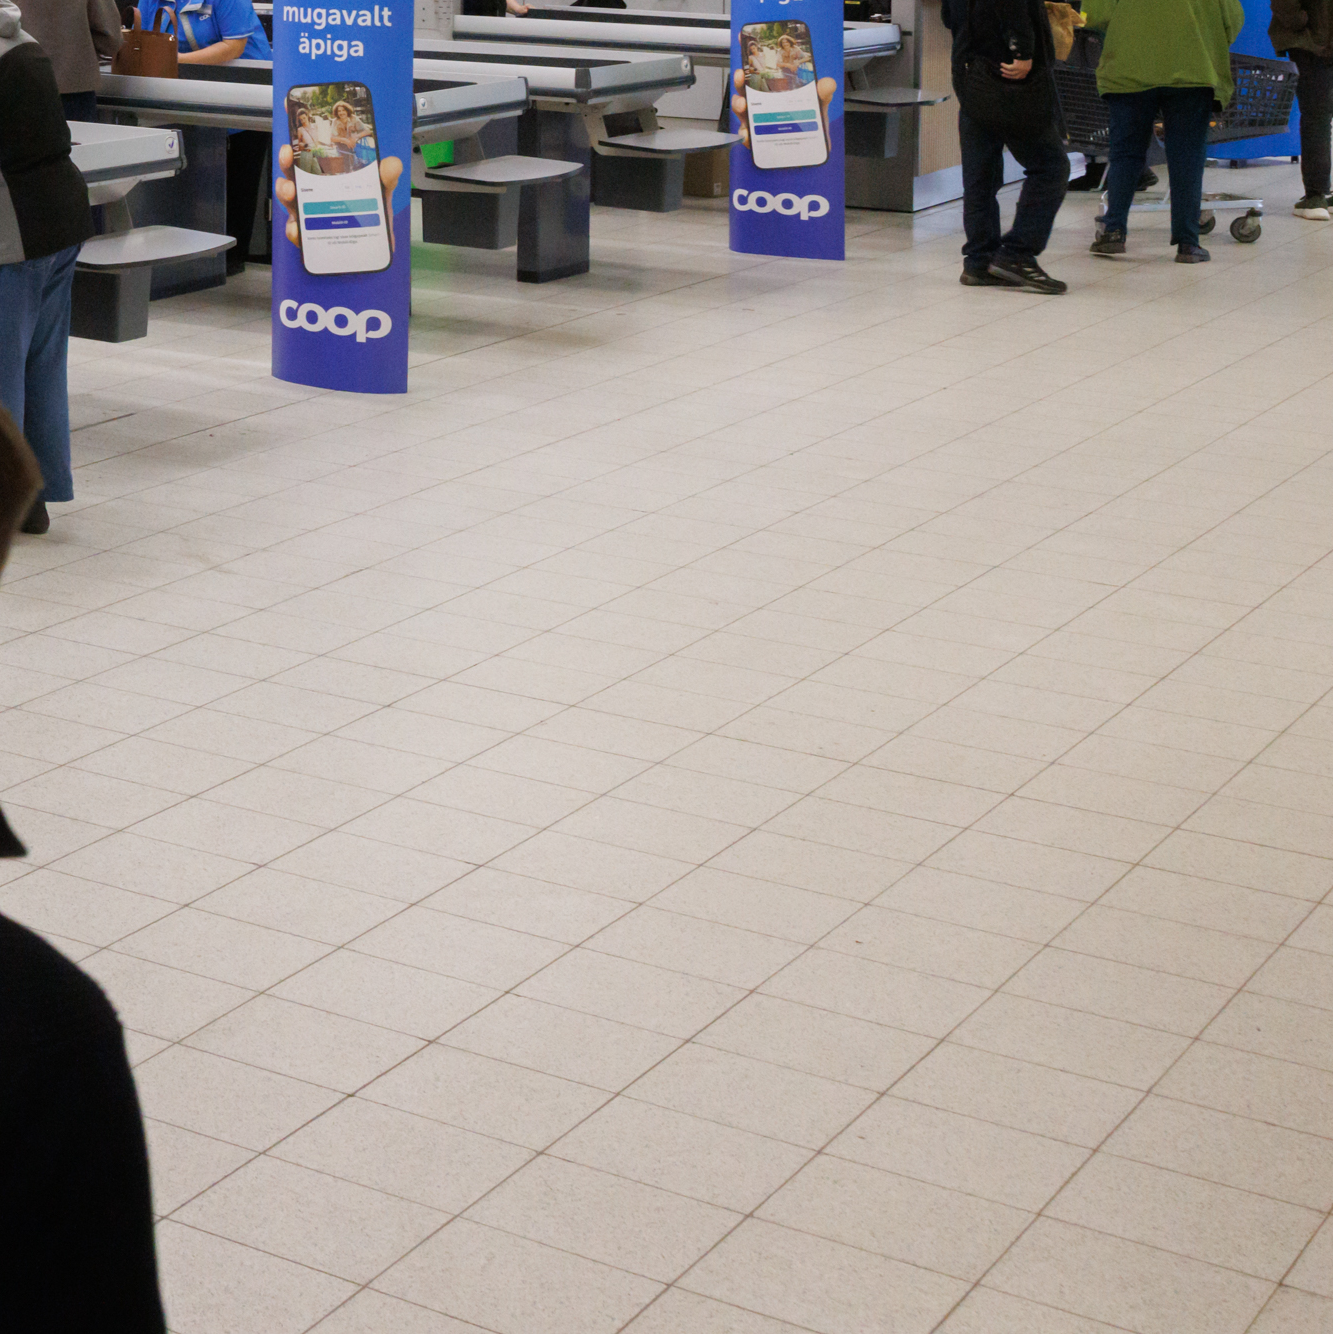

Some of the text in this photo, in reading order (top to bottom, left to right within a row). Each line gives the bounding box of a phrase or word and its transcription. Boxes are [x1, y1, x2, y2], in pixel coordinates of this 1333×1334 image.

[283, 4, 393, 30] mugavalt
[298, 32, 364, 62] äpiga
[733, 187, 831, 221] coop
[279, 298, 393, 343] coop
